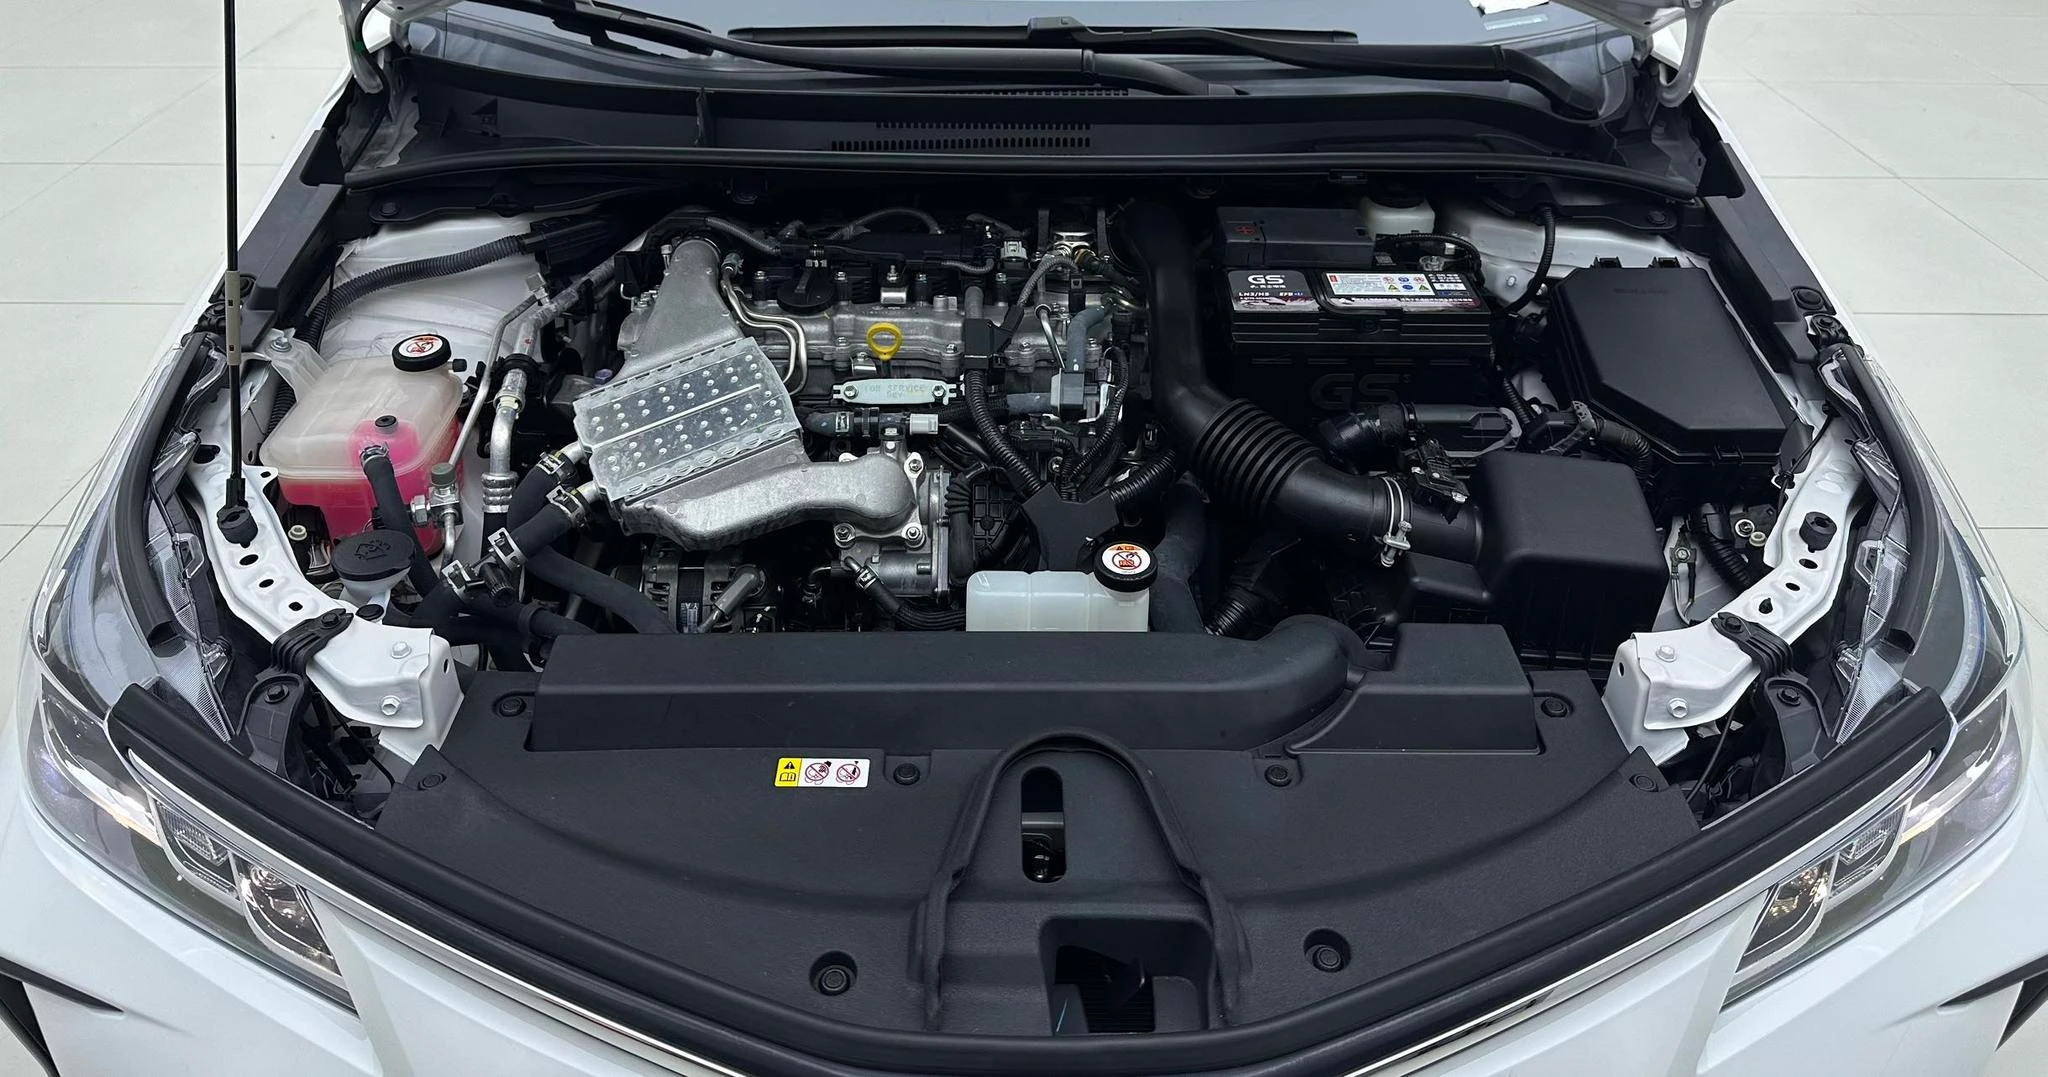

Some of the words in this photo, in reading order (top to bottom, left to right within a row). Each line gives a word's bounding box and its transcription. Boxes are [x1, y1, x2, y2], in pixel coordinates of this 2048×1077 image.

[1248, 275, 1284, 284] GS
[887, 384, 925, 393] SERVICE
[1311, 373, 1400, 411] GS
